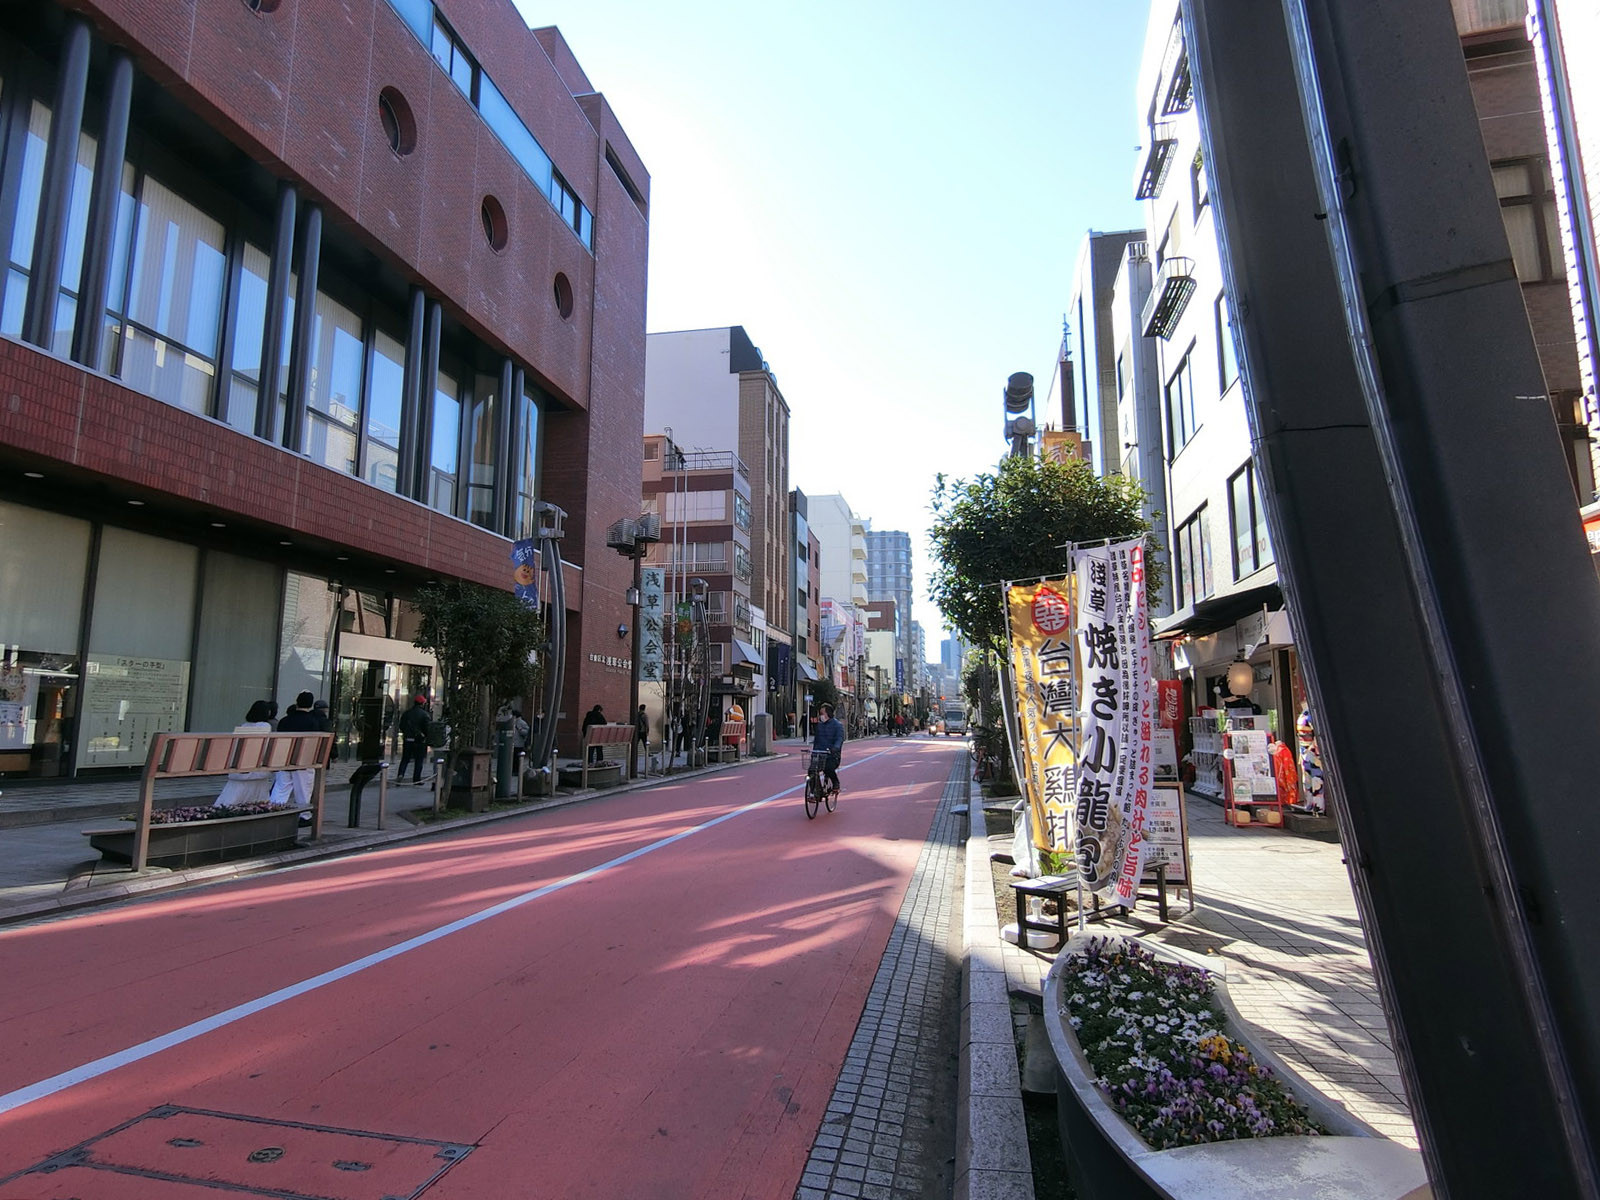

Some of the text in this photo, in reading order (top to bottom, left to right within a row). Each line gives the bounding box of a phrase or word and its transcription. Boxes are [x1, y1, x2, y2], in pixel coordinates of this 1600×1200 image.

[643, 571, 661, 679] 浅草公会堂
